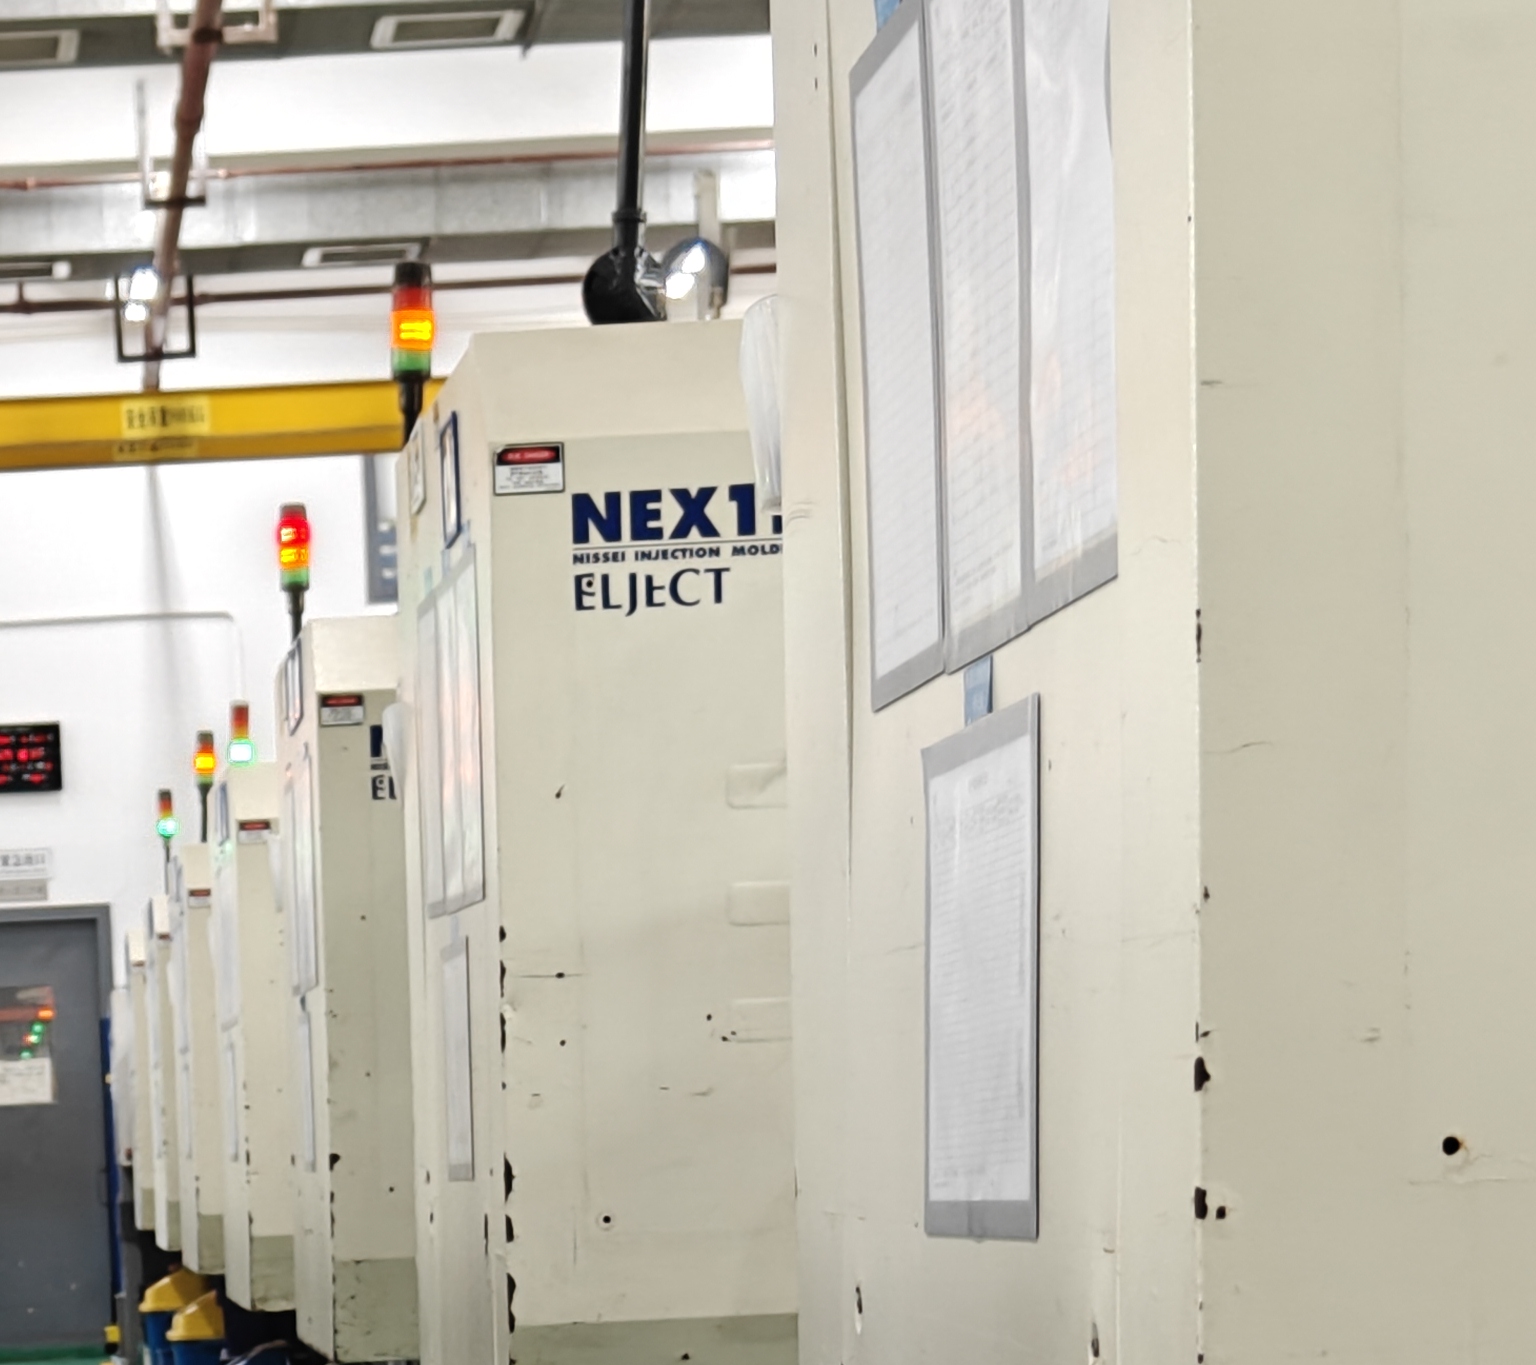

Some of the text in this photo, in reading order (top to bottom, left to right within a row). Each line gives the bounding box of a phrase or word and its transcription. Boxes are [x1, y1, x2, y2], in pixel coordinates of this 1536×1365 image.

[571, 483, 782, 544] NEX1
[572, 543, 782, 565] NISSEI INJECTION MOLD
